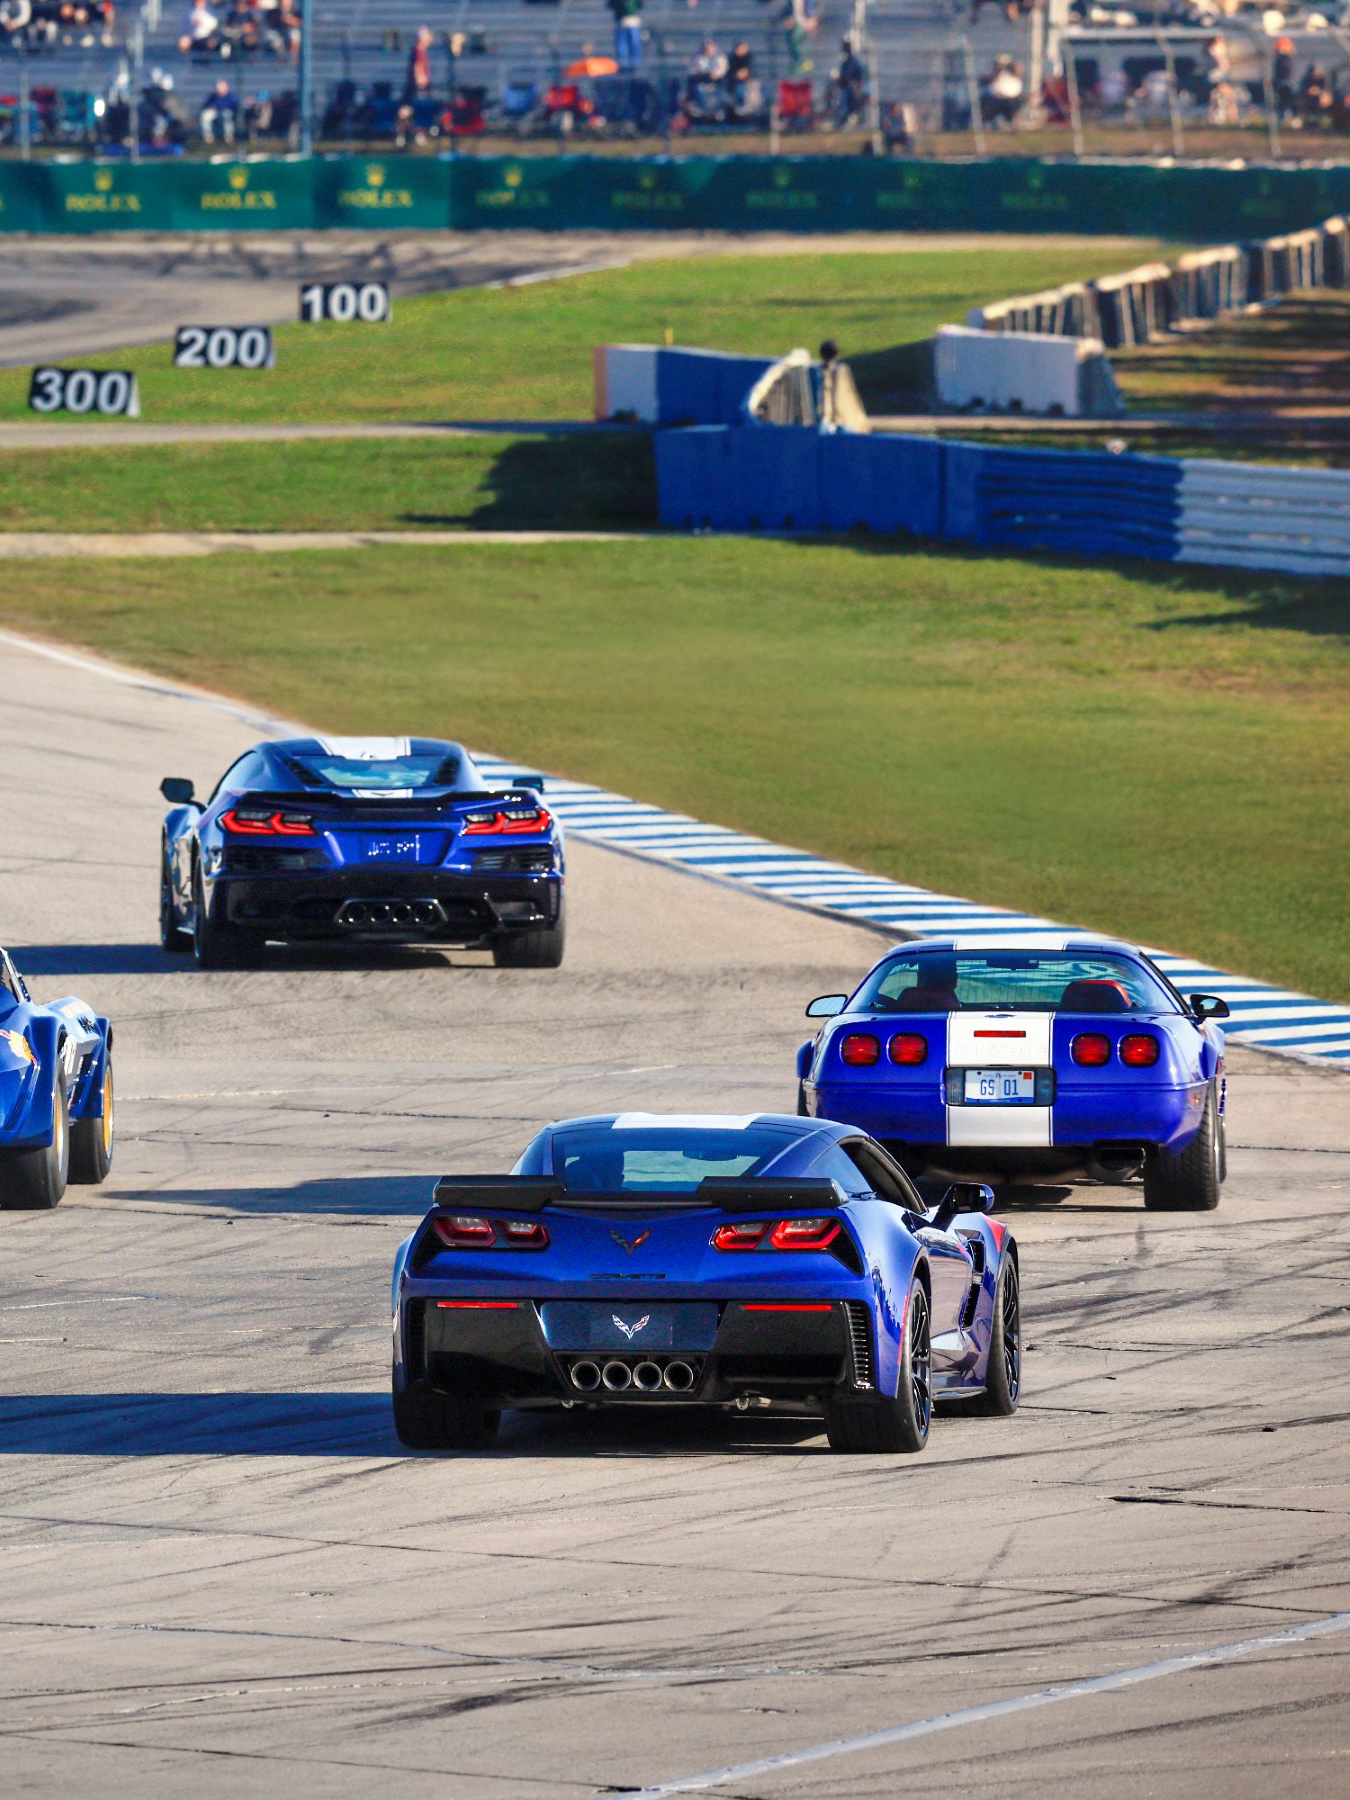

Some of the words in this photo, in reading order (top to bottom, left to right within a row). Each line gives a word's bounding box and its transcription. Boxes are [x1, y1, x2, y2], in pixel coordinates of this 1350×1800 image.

[66, 195, 139, 211] ROLEX
[201, 192, 275, 209] ROLEX
[302, 283, 388, 322] 100
[175, 327, 267, 367] 200
[31, 369, 129, 415] 300
[980, 1079, 995, 1096] GS
[1003, 1079, 1019, 1096] 01
